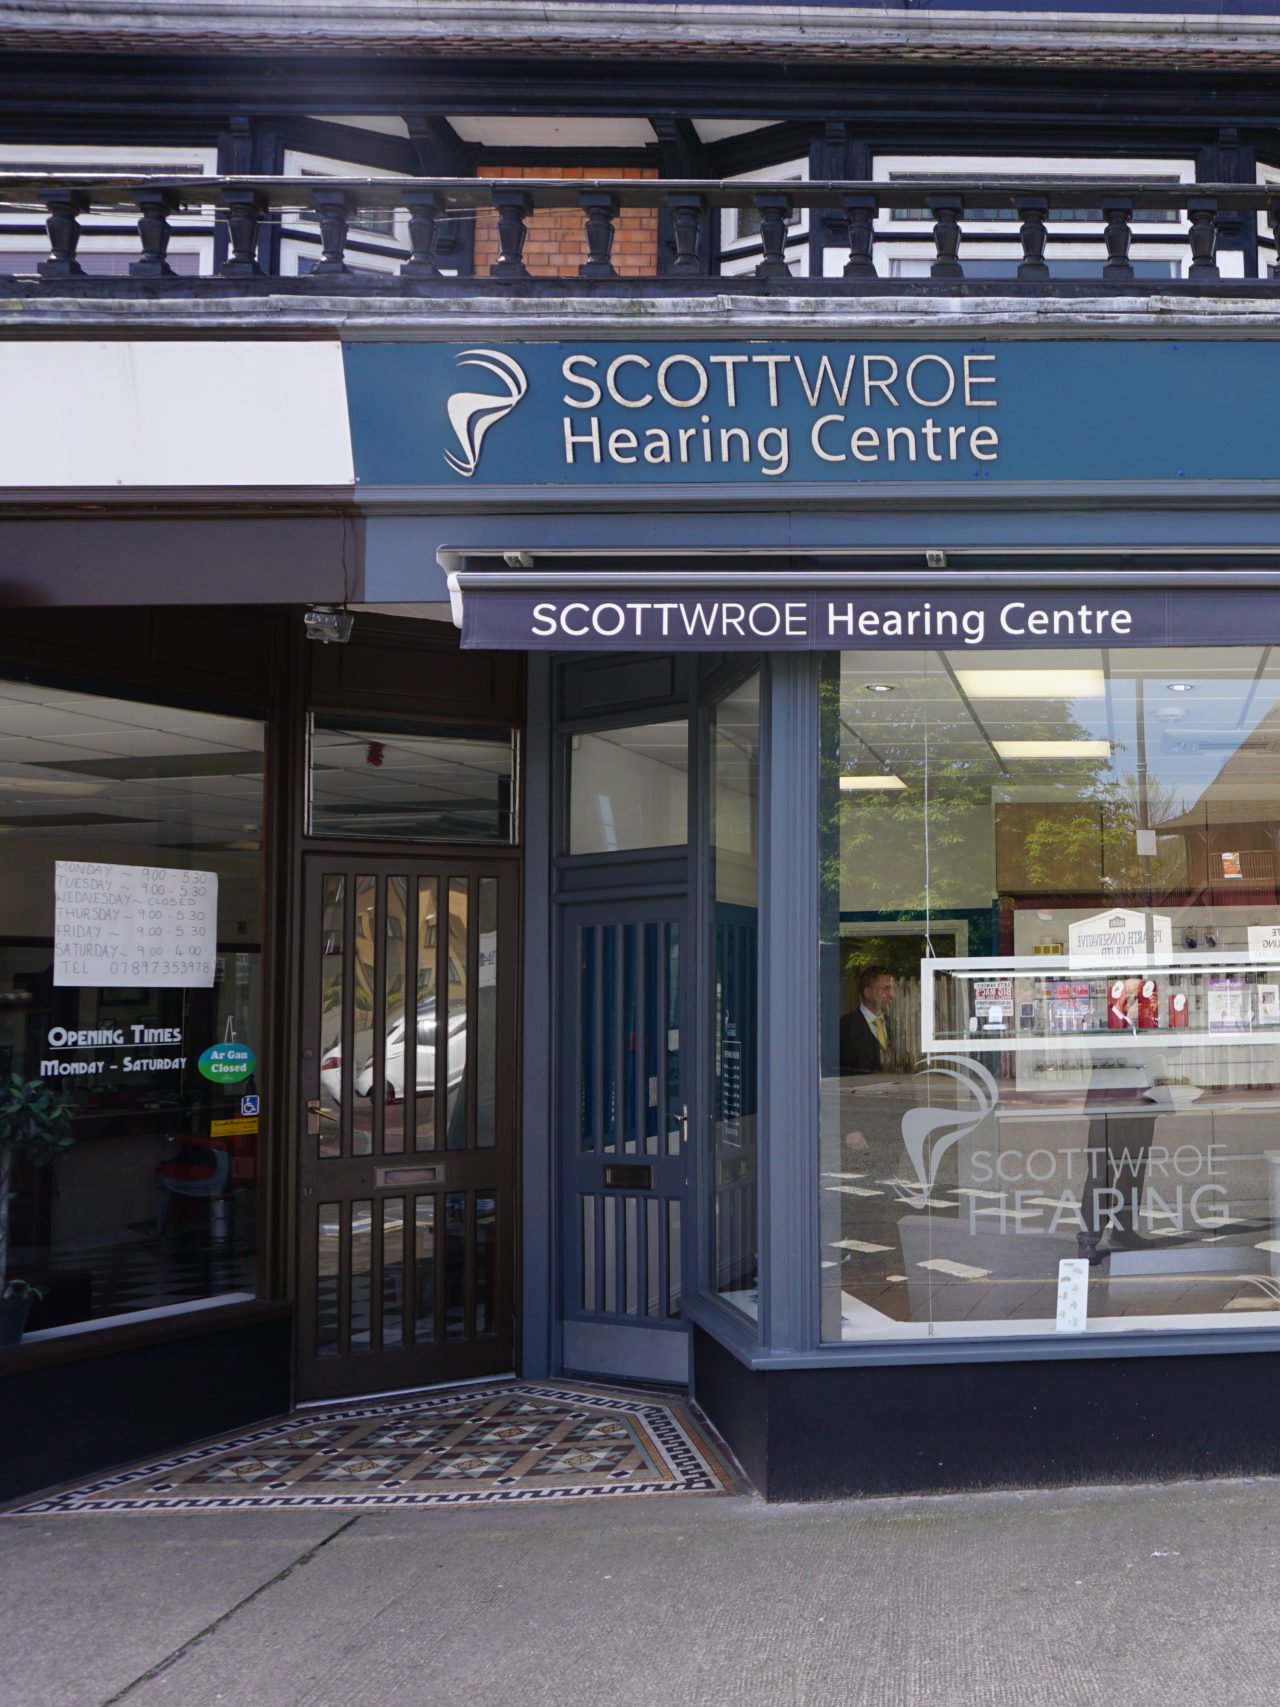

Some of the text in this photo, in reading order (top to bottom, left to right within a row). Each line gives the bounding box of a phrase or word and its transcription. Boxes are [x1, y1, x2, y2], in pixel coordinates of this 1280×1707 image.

[560, 353, 998, 409] SCOTTWROE
[562, 414, 999, 476] Hearing Centre
[531, 601, 1132, 644] SCOTTWROE Hearing Centre
[55, 862, 112, 877] MONDAY
[56, 875, 112, 892] TUESDAY
[56, 891, 132, 906] WEDNESDAY
[147, 898, 196, 906] CLOSED
[56, 907, 120, 921] THURSDAY
[56, 924, 102, 938] FRIDAY
[56, 942, 119, 960] SATURDAY
[61, 960, 210, 976] TEL 07897353978
[48, 1024, 182, 1047] OPENING TIMES
[210, 1050, 248, 1060] Ar Gau
[40, 1060, 104, 1076] MONDAY
[123, 1056, 187, 1072] SATURDAY
[211, 1064, 247, 1073] Closed
[970, 1144, 1228, 1182] SCOTTWROE
[969, 1184, 1230, 1236] HEARING
